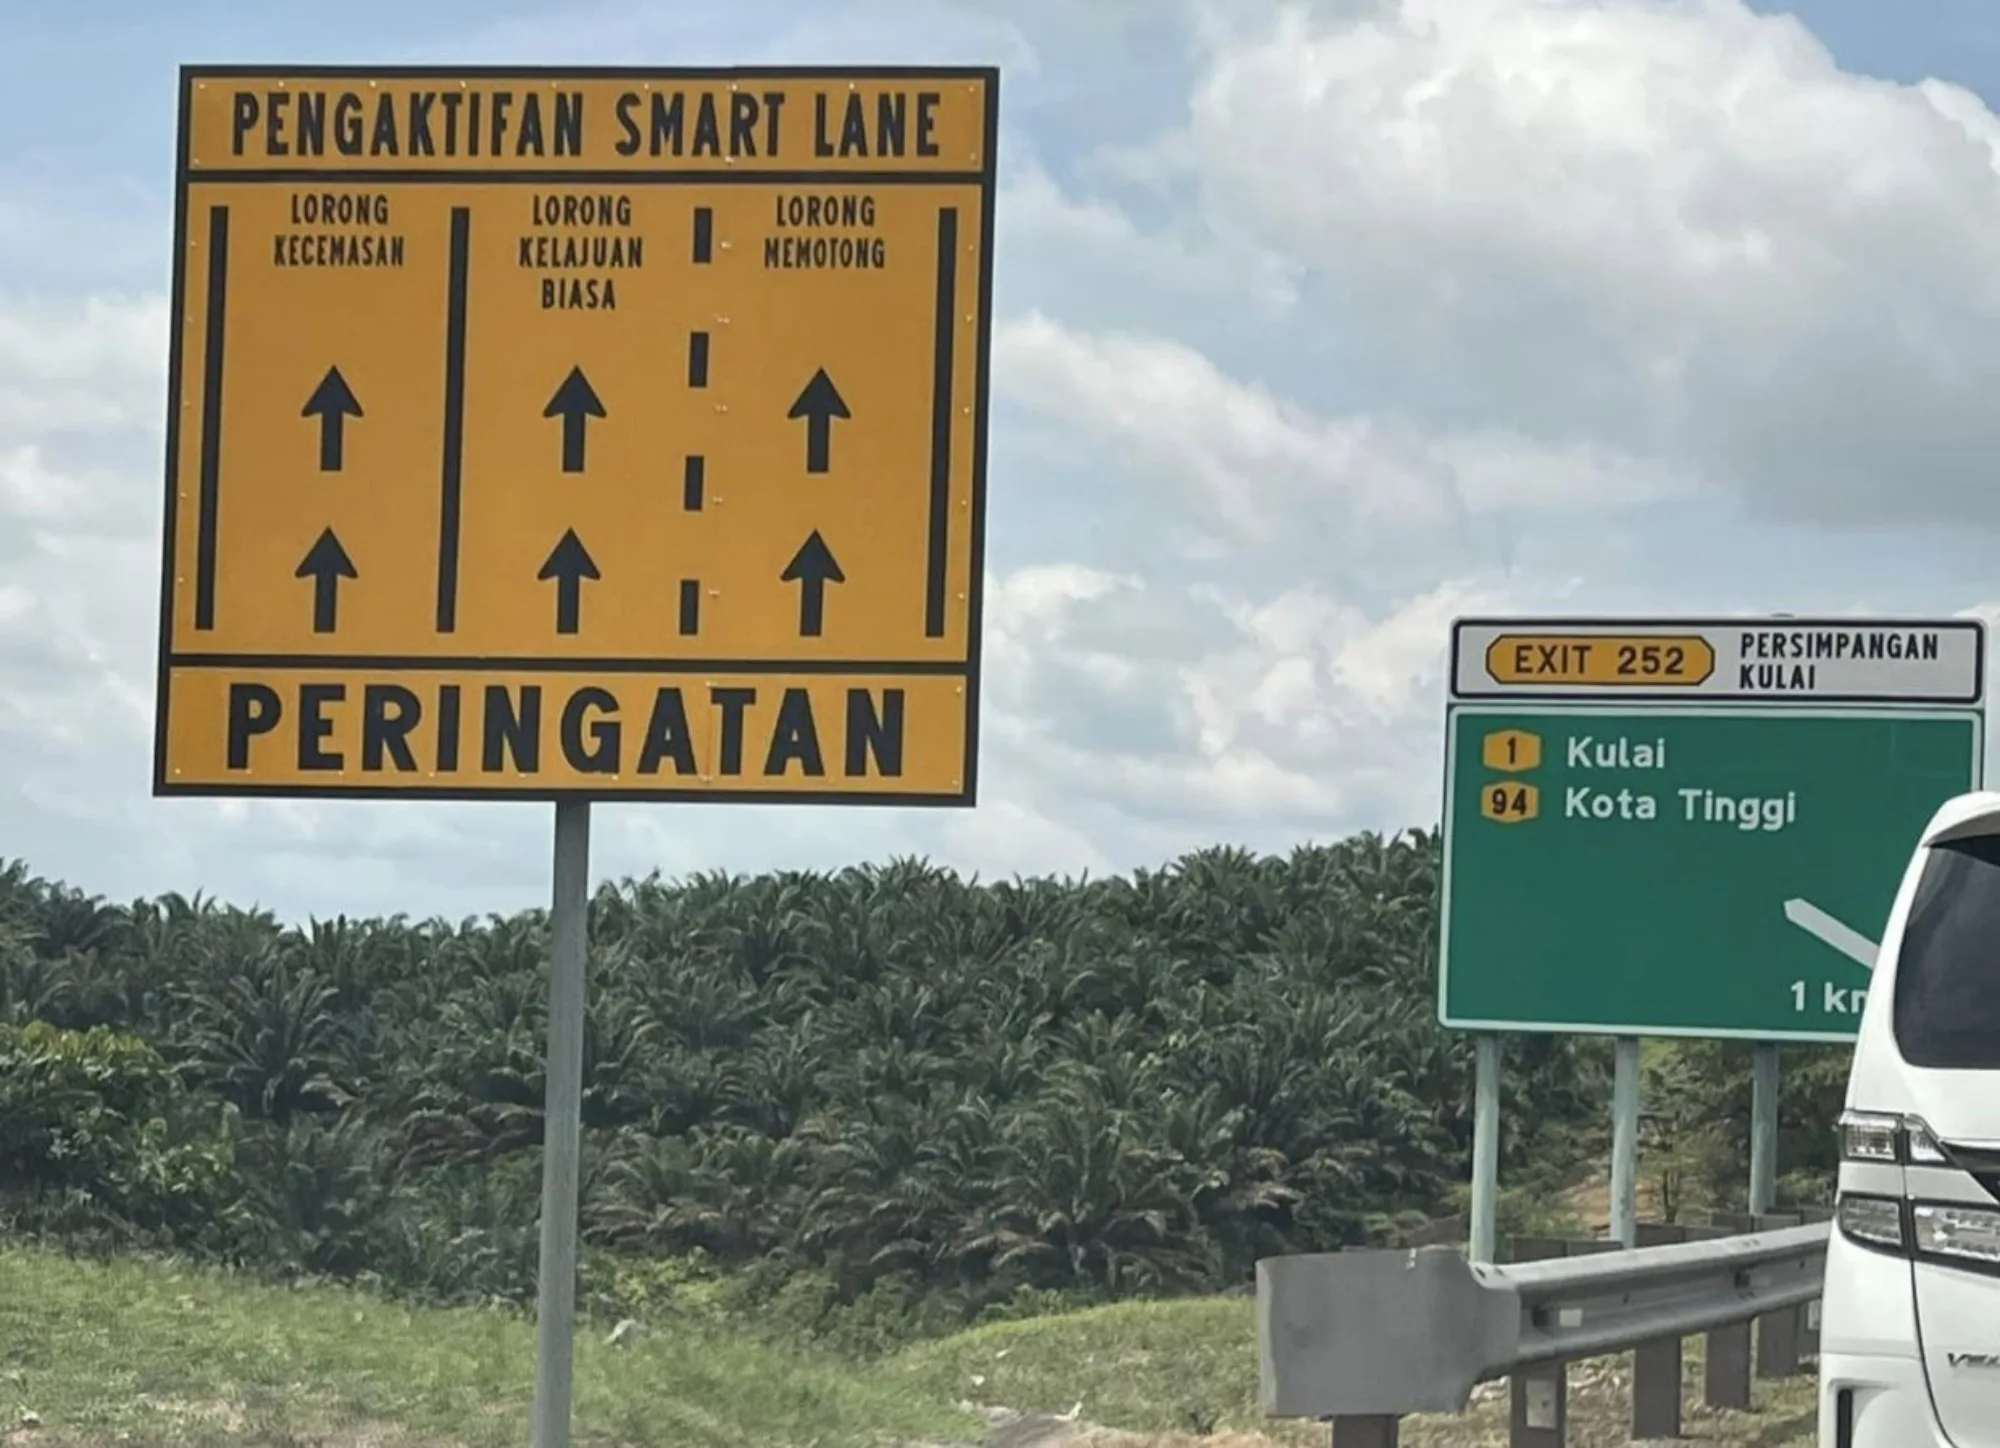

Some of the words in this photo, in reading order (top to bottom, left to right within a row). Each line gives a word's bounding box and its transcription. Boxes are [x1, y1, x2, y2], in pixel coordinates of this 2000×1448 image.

[233, 92, 582, 156] PENGAKTIFAN
[615, 92, 785, 156] SMART
[815, 93, 940, 157] LANE
[292, 194, 388, 225] LORONG
[534, 195, 631, 226] LORONG
[777, 195, 874, 227] LORONG
[274, 235, 403, 266] KECEMASAN
[520, 237, 642, 268] KELAJUAN
[765, 237, 884, 268] MEMOTONG
[542, 278, 615, 309] BIASA
[1515, 645, 1592, 674] EXIT
[1618, 646, 1683, 674] 252
[1741, 633, 1937, 659] PERSIMPANGAN
[1740, 664, 1815, 689] KULAI
[227, 685, 904, 777] PERINGATAN
[1508, 737, 1516, 764] 1
[1568, 737, 1664, 768] Kulai
[1492, 789, 1526, 815] 94
[1566, 788, 1655, 819] Kota
[1678, 789, 1795, 829] Tinggi
[1790, 980, 1805, 1011] 1
